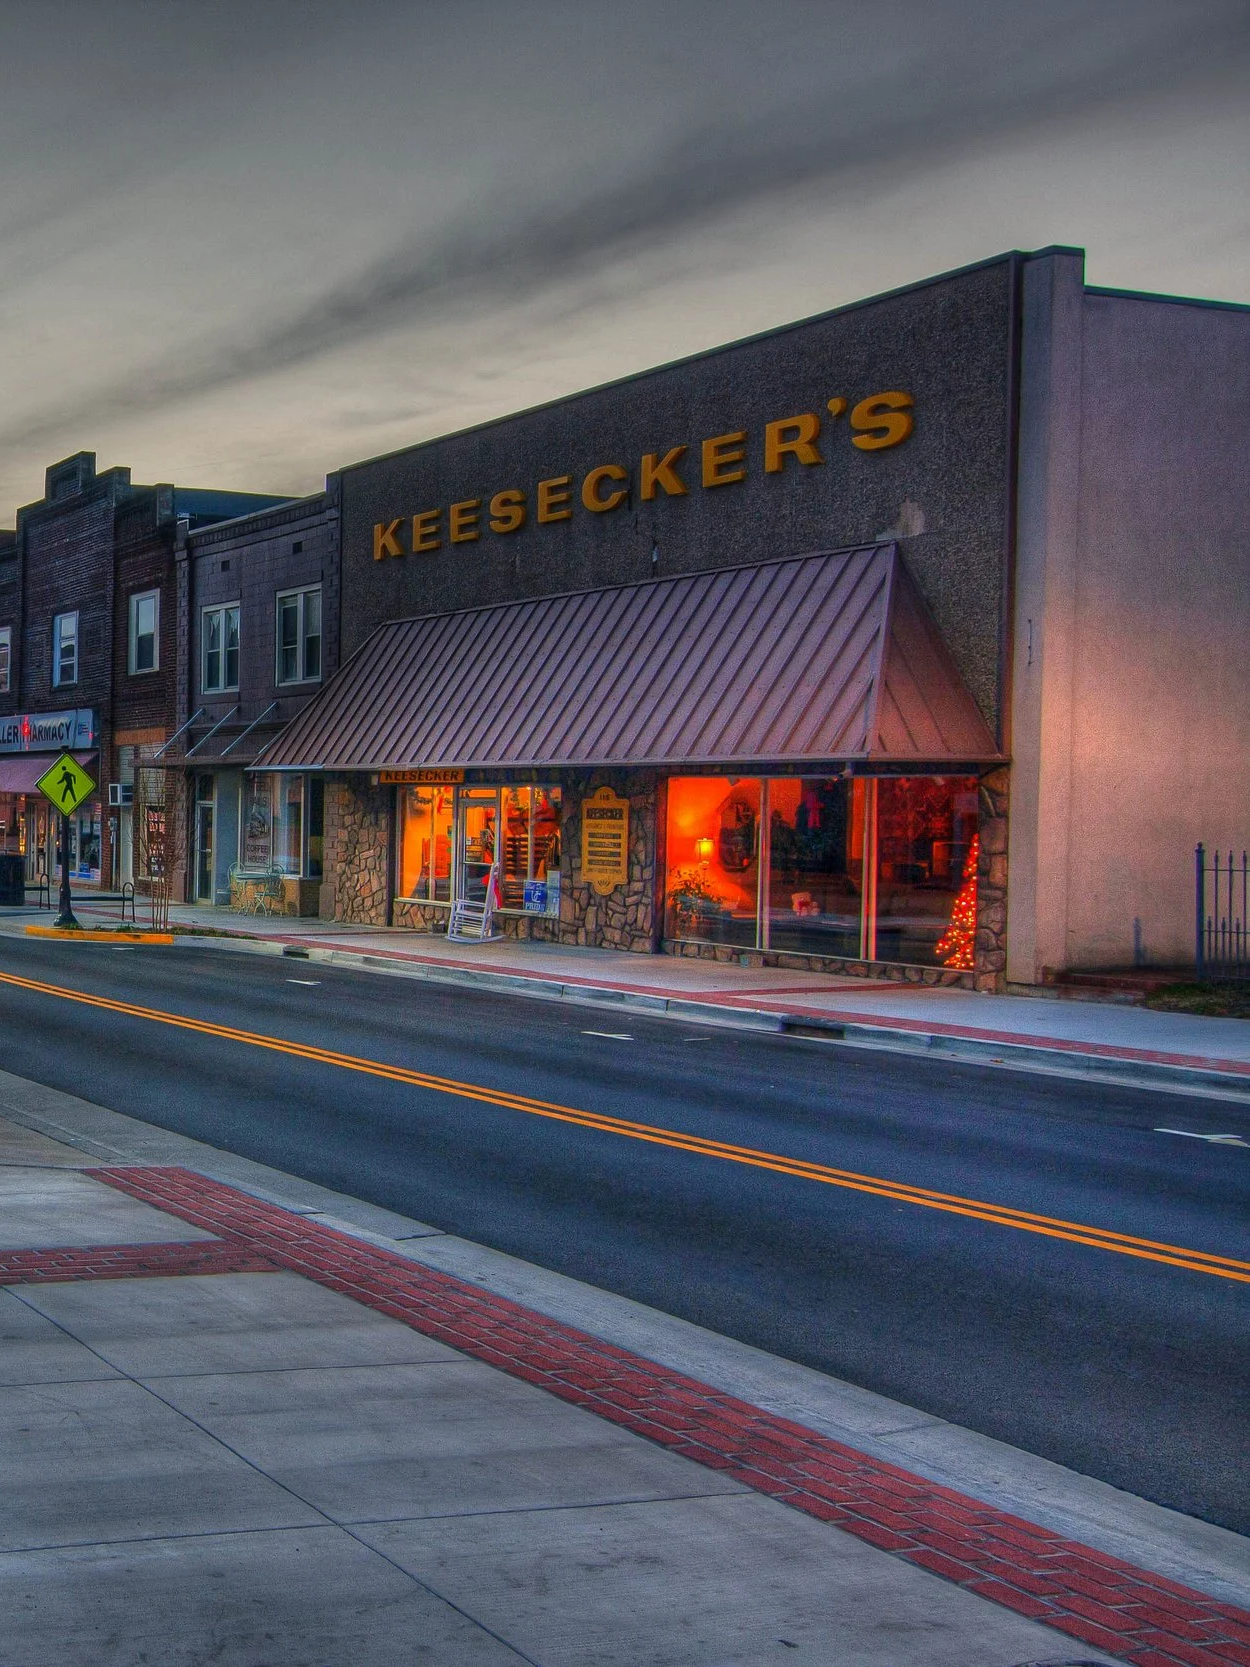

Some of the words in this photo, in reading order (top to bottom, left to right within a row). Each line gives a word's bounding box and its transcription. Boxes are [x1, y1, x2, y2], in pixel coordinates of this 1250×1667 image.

[373, 391, 914, 561] KEESECKER'S
[386, 769, 459, 781] KEESECKER
[246, 844, 269, 854] COFFEE
[248, 855, 267, 864] HOUSE
